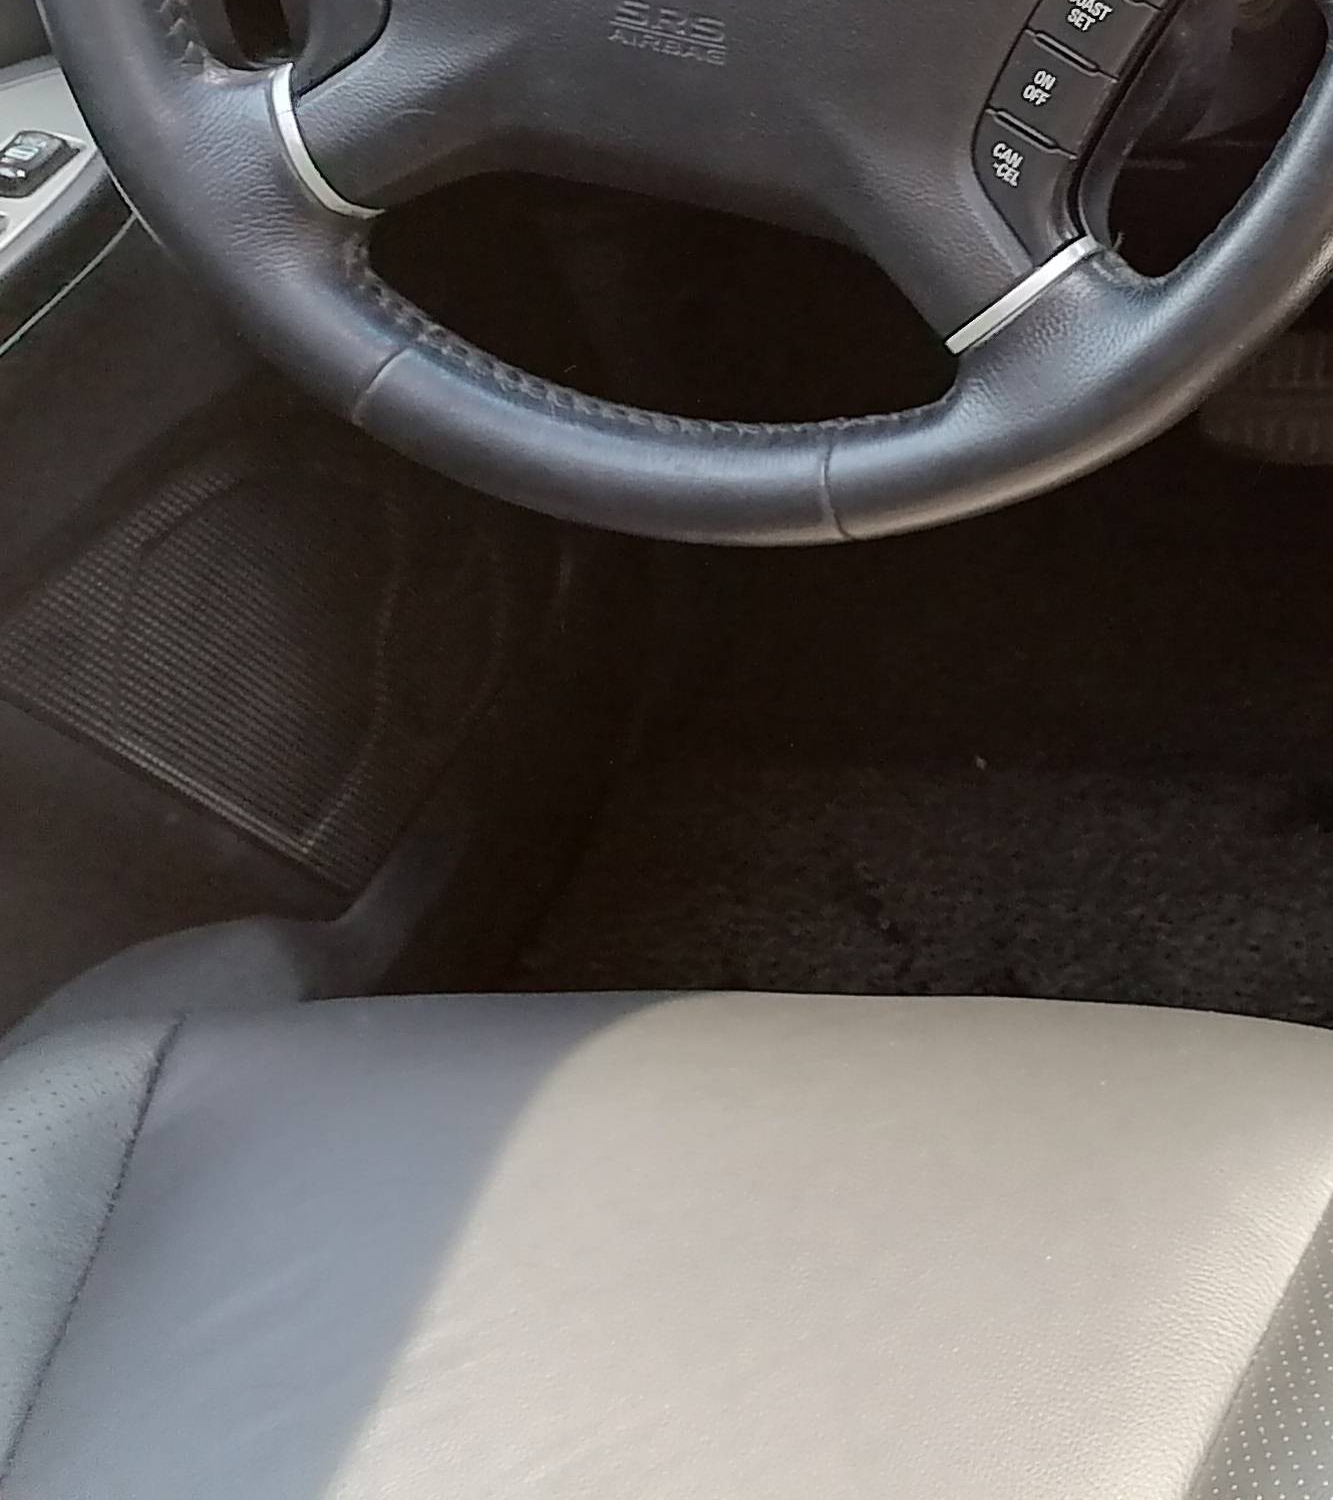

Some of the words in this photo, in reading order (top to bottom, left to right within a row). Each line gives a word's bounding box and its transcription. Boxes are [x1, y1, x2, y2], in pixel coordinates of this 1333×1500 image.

[1067, 8, 1095, 31] SET
[1033, 70, 1056, 91] ON
[1023, 84, 1051, 106] OFF
[993, 142, 1023, 168] CAN
